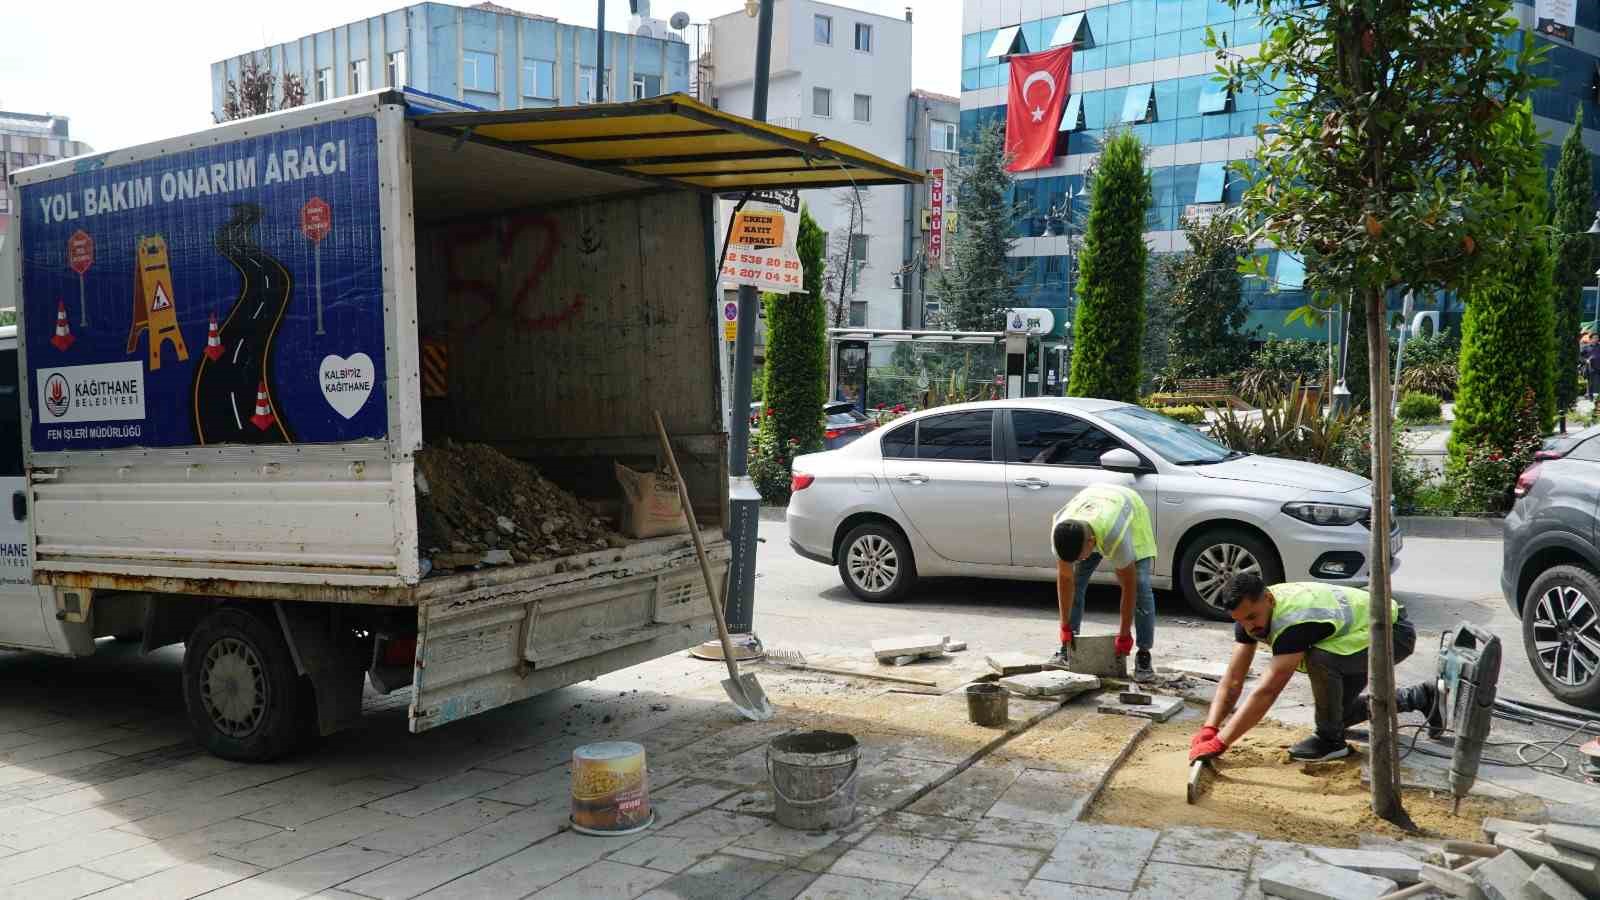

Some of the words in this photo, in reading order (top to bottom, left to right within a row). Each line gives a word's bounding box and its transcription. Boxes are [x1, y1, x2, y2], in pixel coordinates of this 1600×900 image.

[39, 191, 79, 224] YOL
[84, 176, 153, 217] BAKIM
[160, 157, 257, 203] ONARIM
[264, 139, 347, 186] ARACI
[743, 215, 773, 224] ERKEN
[743, 226, 771, 234] KAYIT
[738, 236, 775, 245] FIRSATI
[766, 256, 781, 268] 20
[784, 260, 799, 270] 20
[740, 268, 761, 279] 207
[765, 272, 780, 281] 04
[784, 273, 799, 283] 34
[75, 394, 139, 408] BELEDİYESİ
[47, 429, 62, 440] FEN
[63, 426, 88, 440] İŞLERİ
[89, 424, 142, 439] MÜDÜRLÜĞÜ
